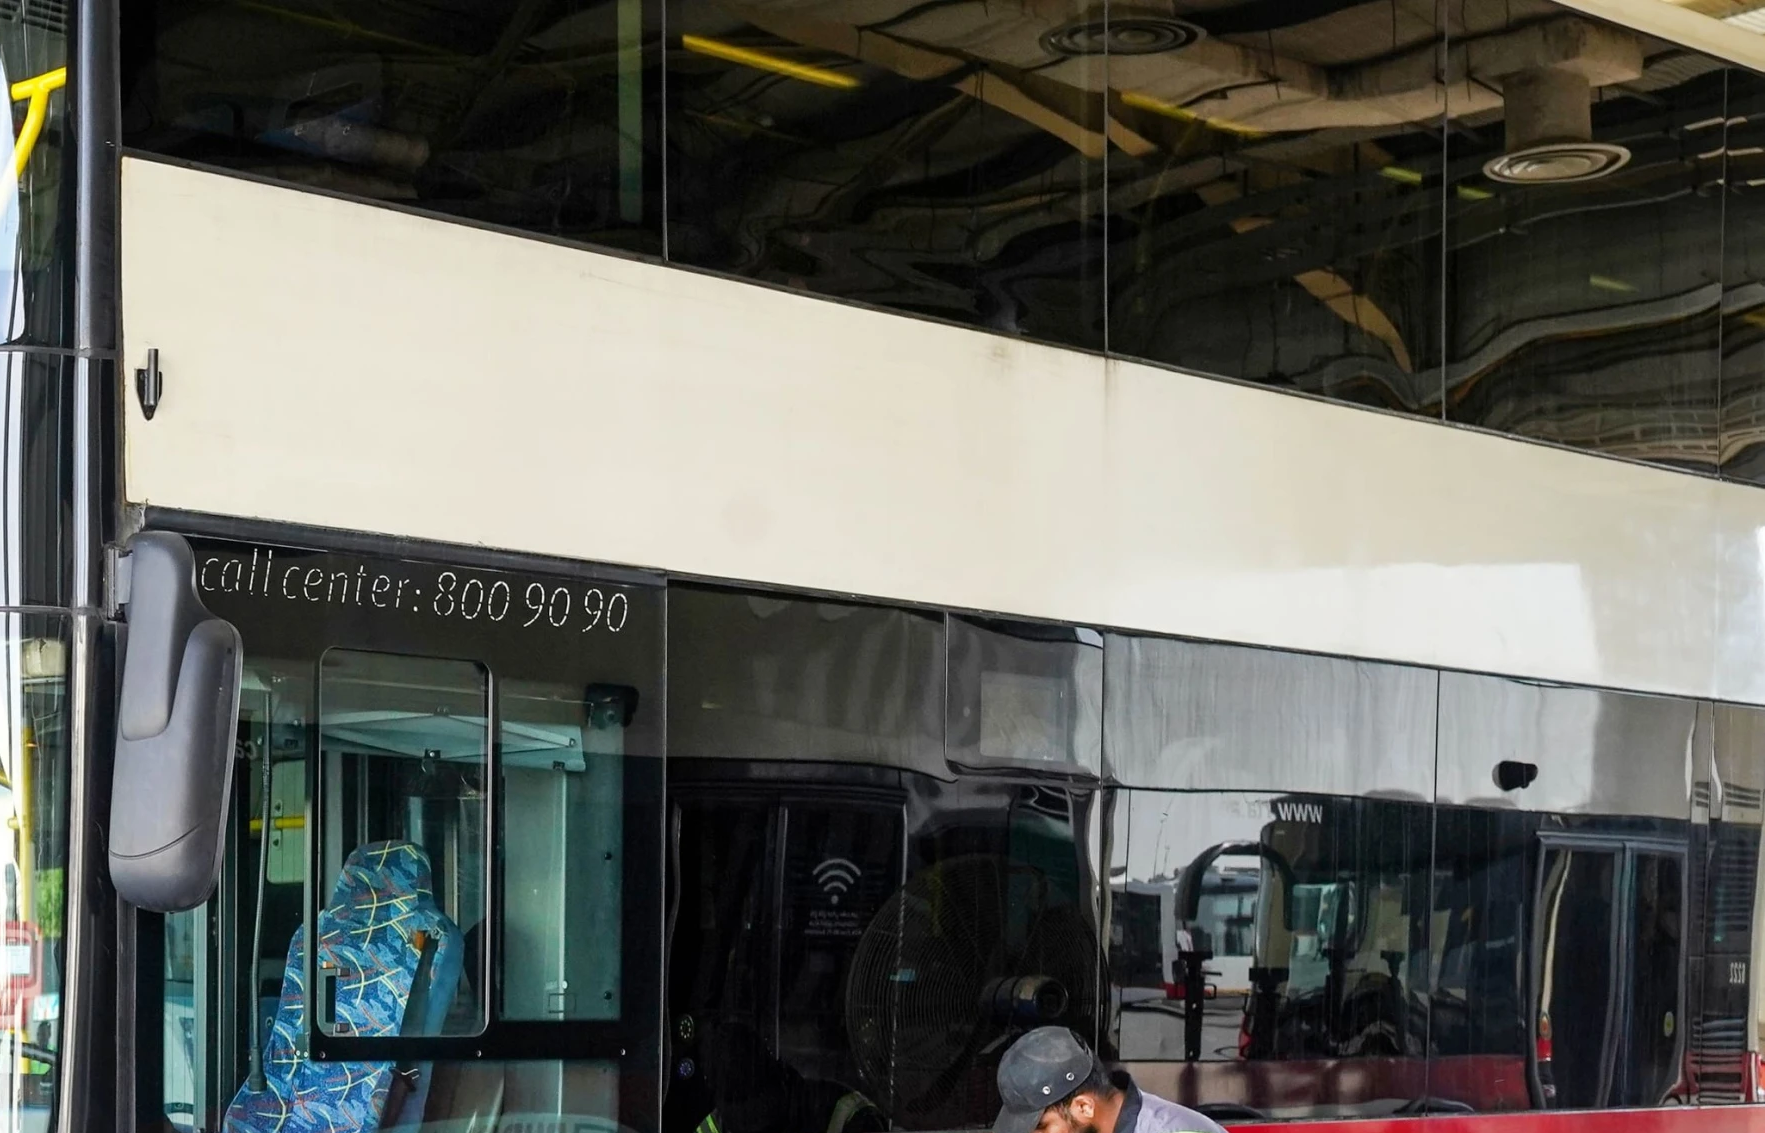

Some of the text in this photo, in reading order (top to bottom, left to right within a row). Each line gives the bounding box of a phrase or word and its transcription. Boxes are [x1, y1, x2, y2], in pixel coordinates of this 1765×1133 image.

[201, 548, 629, 633] call center: 800 90 90
